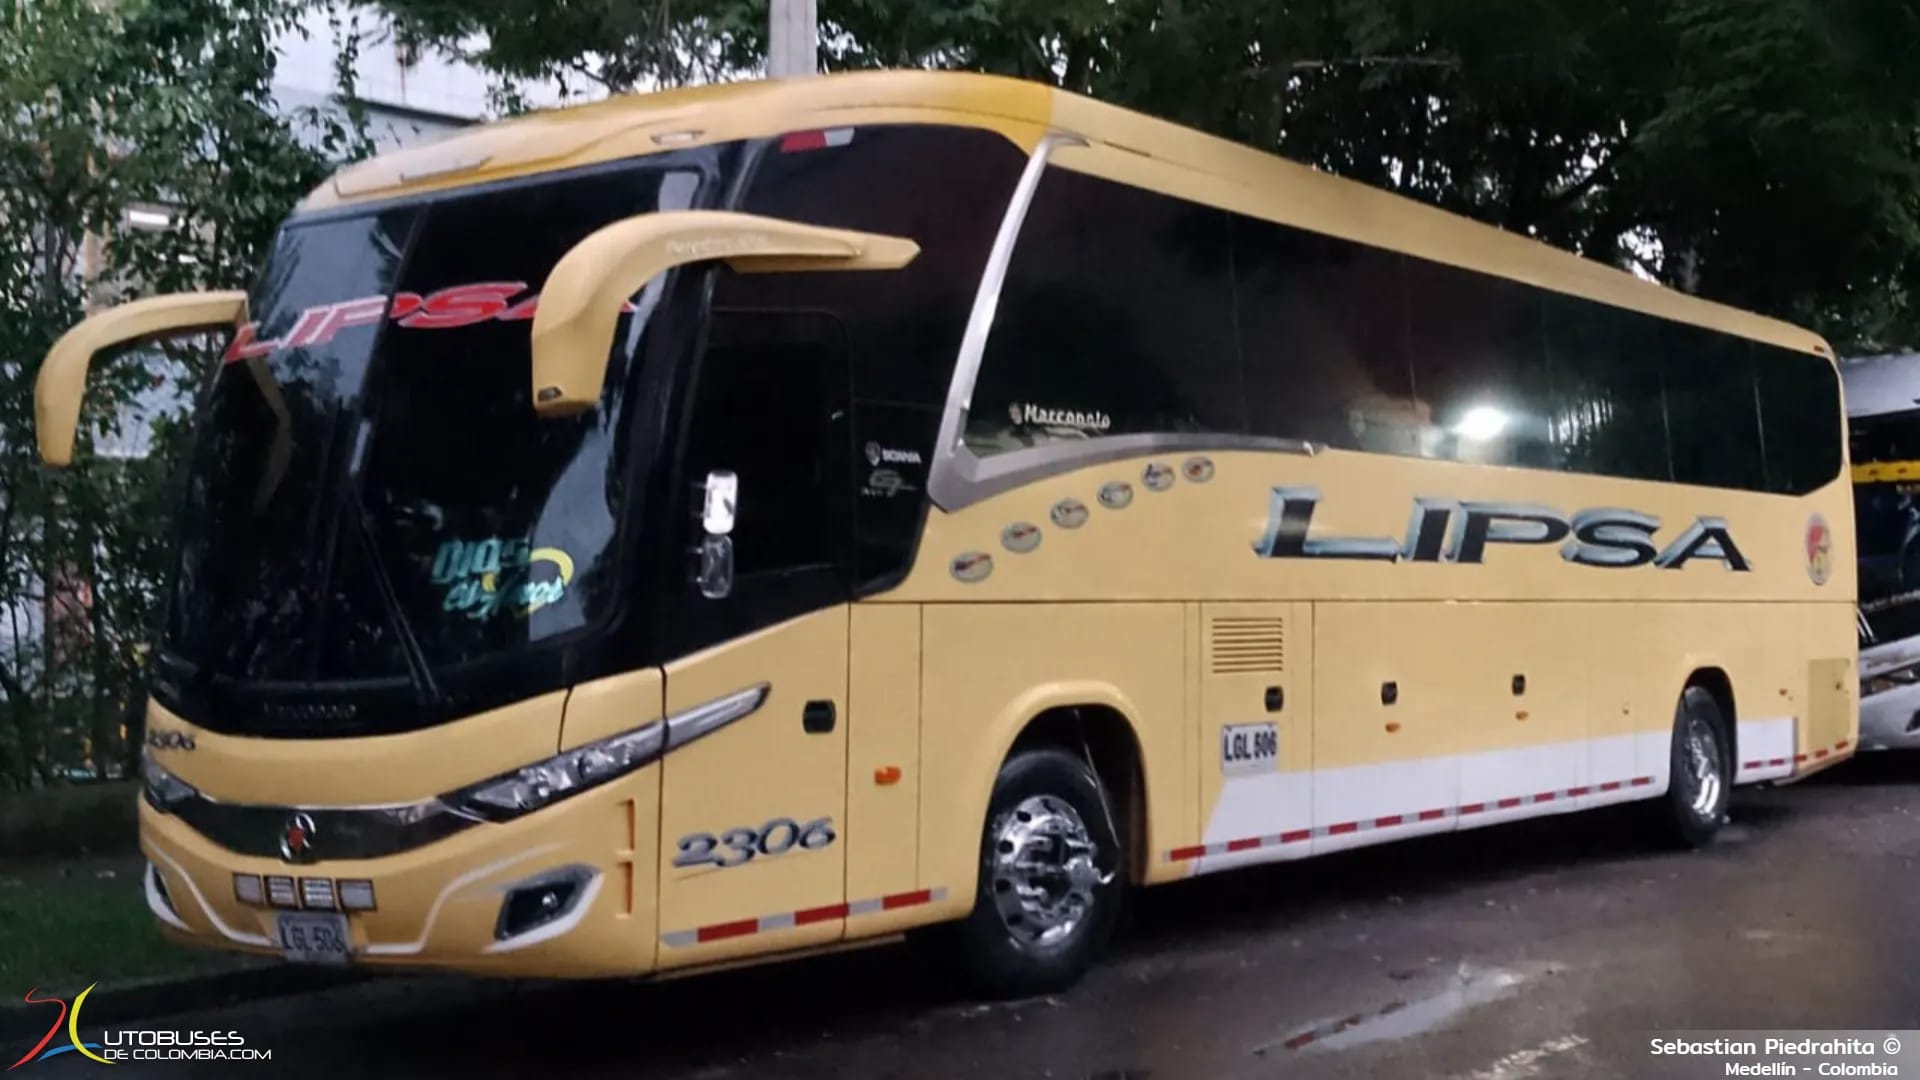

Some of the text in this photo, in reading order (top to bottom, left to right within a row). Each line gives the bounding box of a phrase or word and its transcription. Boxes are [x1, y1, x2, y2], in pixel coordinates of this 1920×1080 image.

[1024, 403, 1111, 429] Marcopolo
[1253, 486, 1752, 572] LIPSA
[1224, 733, 1251, 761] LGL
[672, 816, 836, 868] 2306
